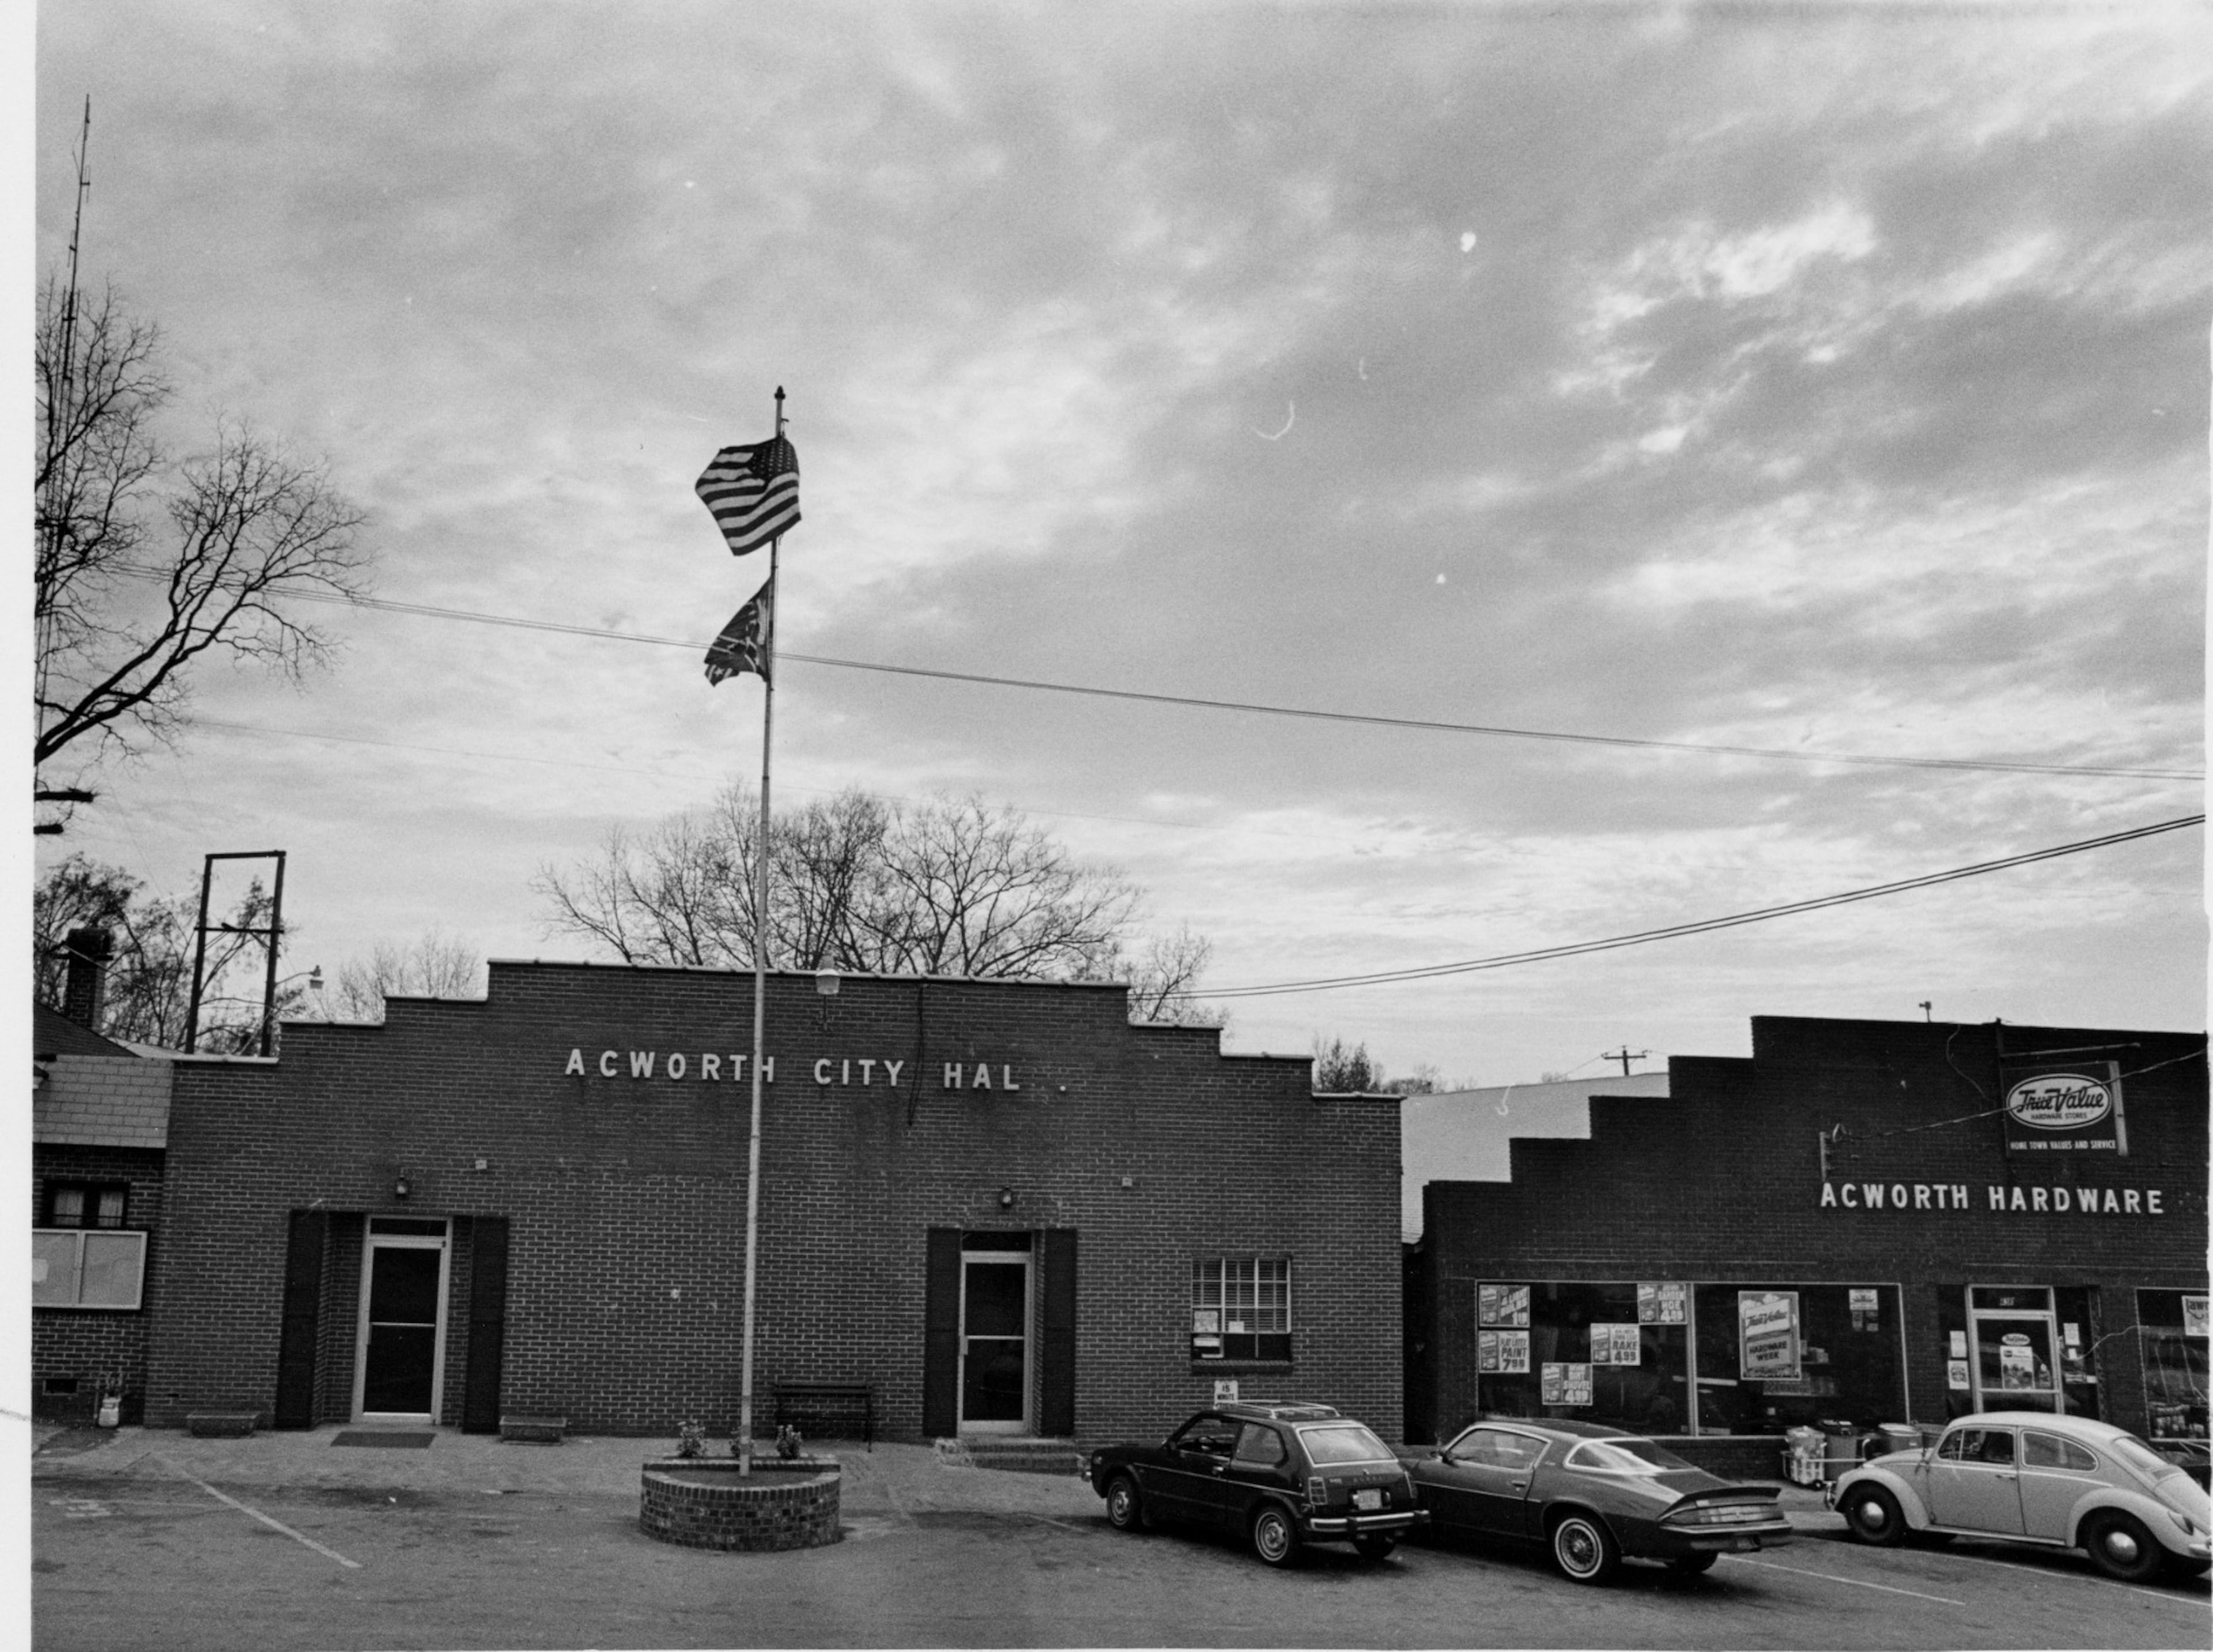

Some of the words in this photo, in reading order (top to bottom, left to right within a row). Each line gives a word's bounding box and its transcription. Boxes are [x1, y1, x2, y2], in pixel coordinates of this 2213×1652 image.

[565, 1048, 775, 1083] ACWORTH
[814, 1058, 905, 1087] CITY
[943, 1062, 1020, 1091] HAL
[2017, 1090, 2053, 1113] True
[2044, 1086, 2104, 1113] Value
[2010, 1141, 2027, 1150] HOME
[2029, 1141, 2048, 1150] TOWN
[2049, 1140, 2072, 1150] VALUES
[2075, 1140, 2089, 1149] AND
[2090, 1139, 2117, 1149] SERVICE
[1820, 1182, 1969, 1209] ACWORTH
[1988, 1185, 2163, 1214] HARDWARE
[1661, 1301, 1681, 1309] HOE
[1613, 1341, 1638, 1350] RAKE
[1749, 1340, 1788, 1354] HARDWARE
[1501, 1347, 1527, 1358] PAINT
[1757, 1351, 1780, 1362] WEEK
[1222, 1385, 1230, 1393] 15
[1563, 1380, 1591, 1390] SHOVEL
